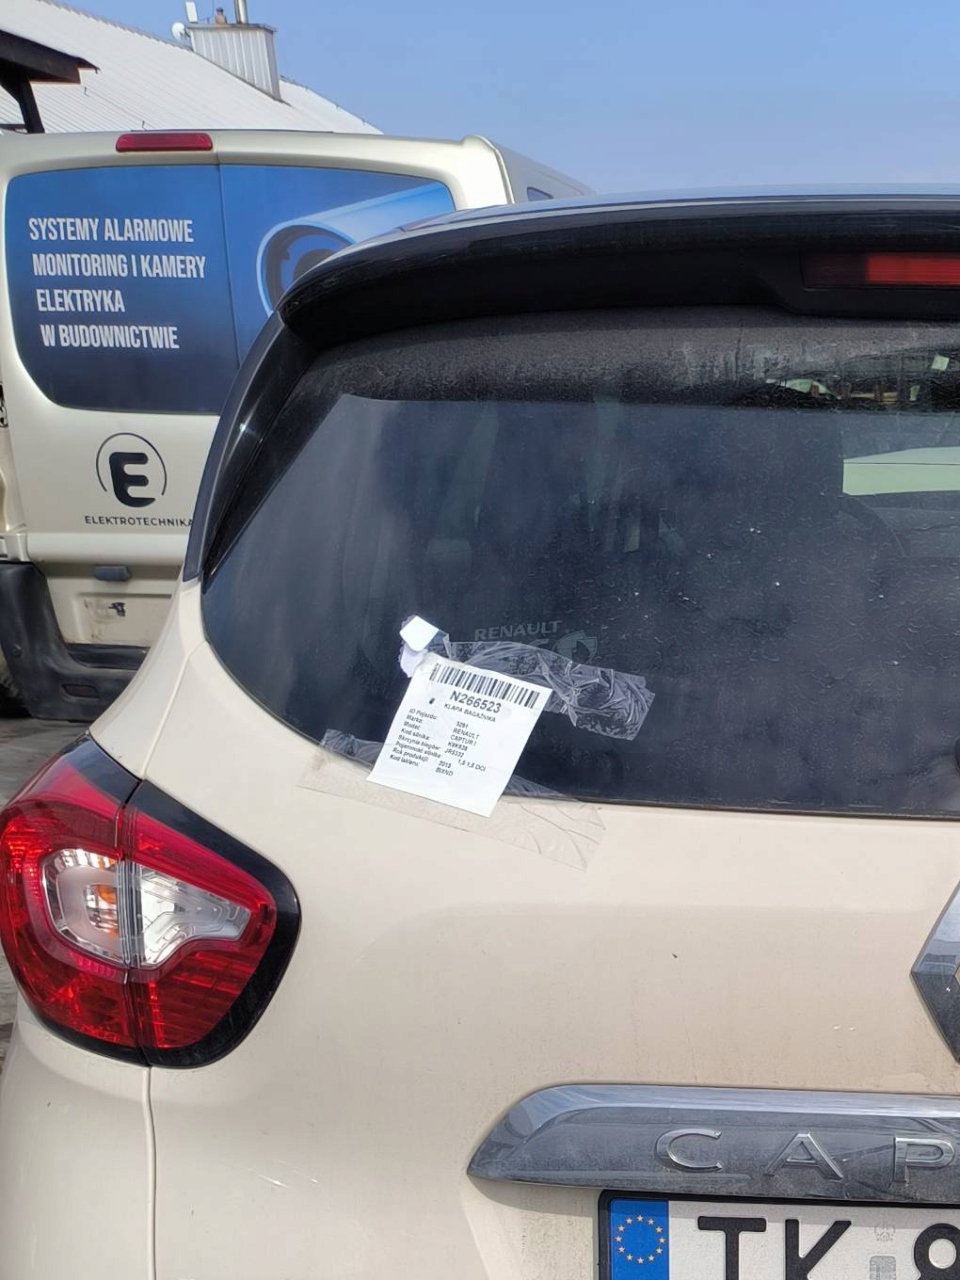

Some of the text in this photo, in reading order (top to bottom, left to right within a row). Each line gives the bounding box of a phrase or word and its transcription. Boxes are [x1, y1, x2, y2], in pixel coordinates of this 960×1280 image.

[29, 218, 194, 242] SYSTEMY ALARMOWE
[32, 254, 206, 278] MONITORING I KAMERY
[36, 289, 125, 312] ELEKTRYKA
[40, 325, 180, 349] W BUDOWNICTWIE
[474, 621, 562, 641] RENAULT
[443, 702, 463, 712] KLAPA
[449, 689, 502, 714] N266523
[449, 734, 473, 745] CAPTUR
[452, 728, 479, 739] RENAULT
